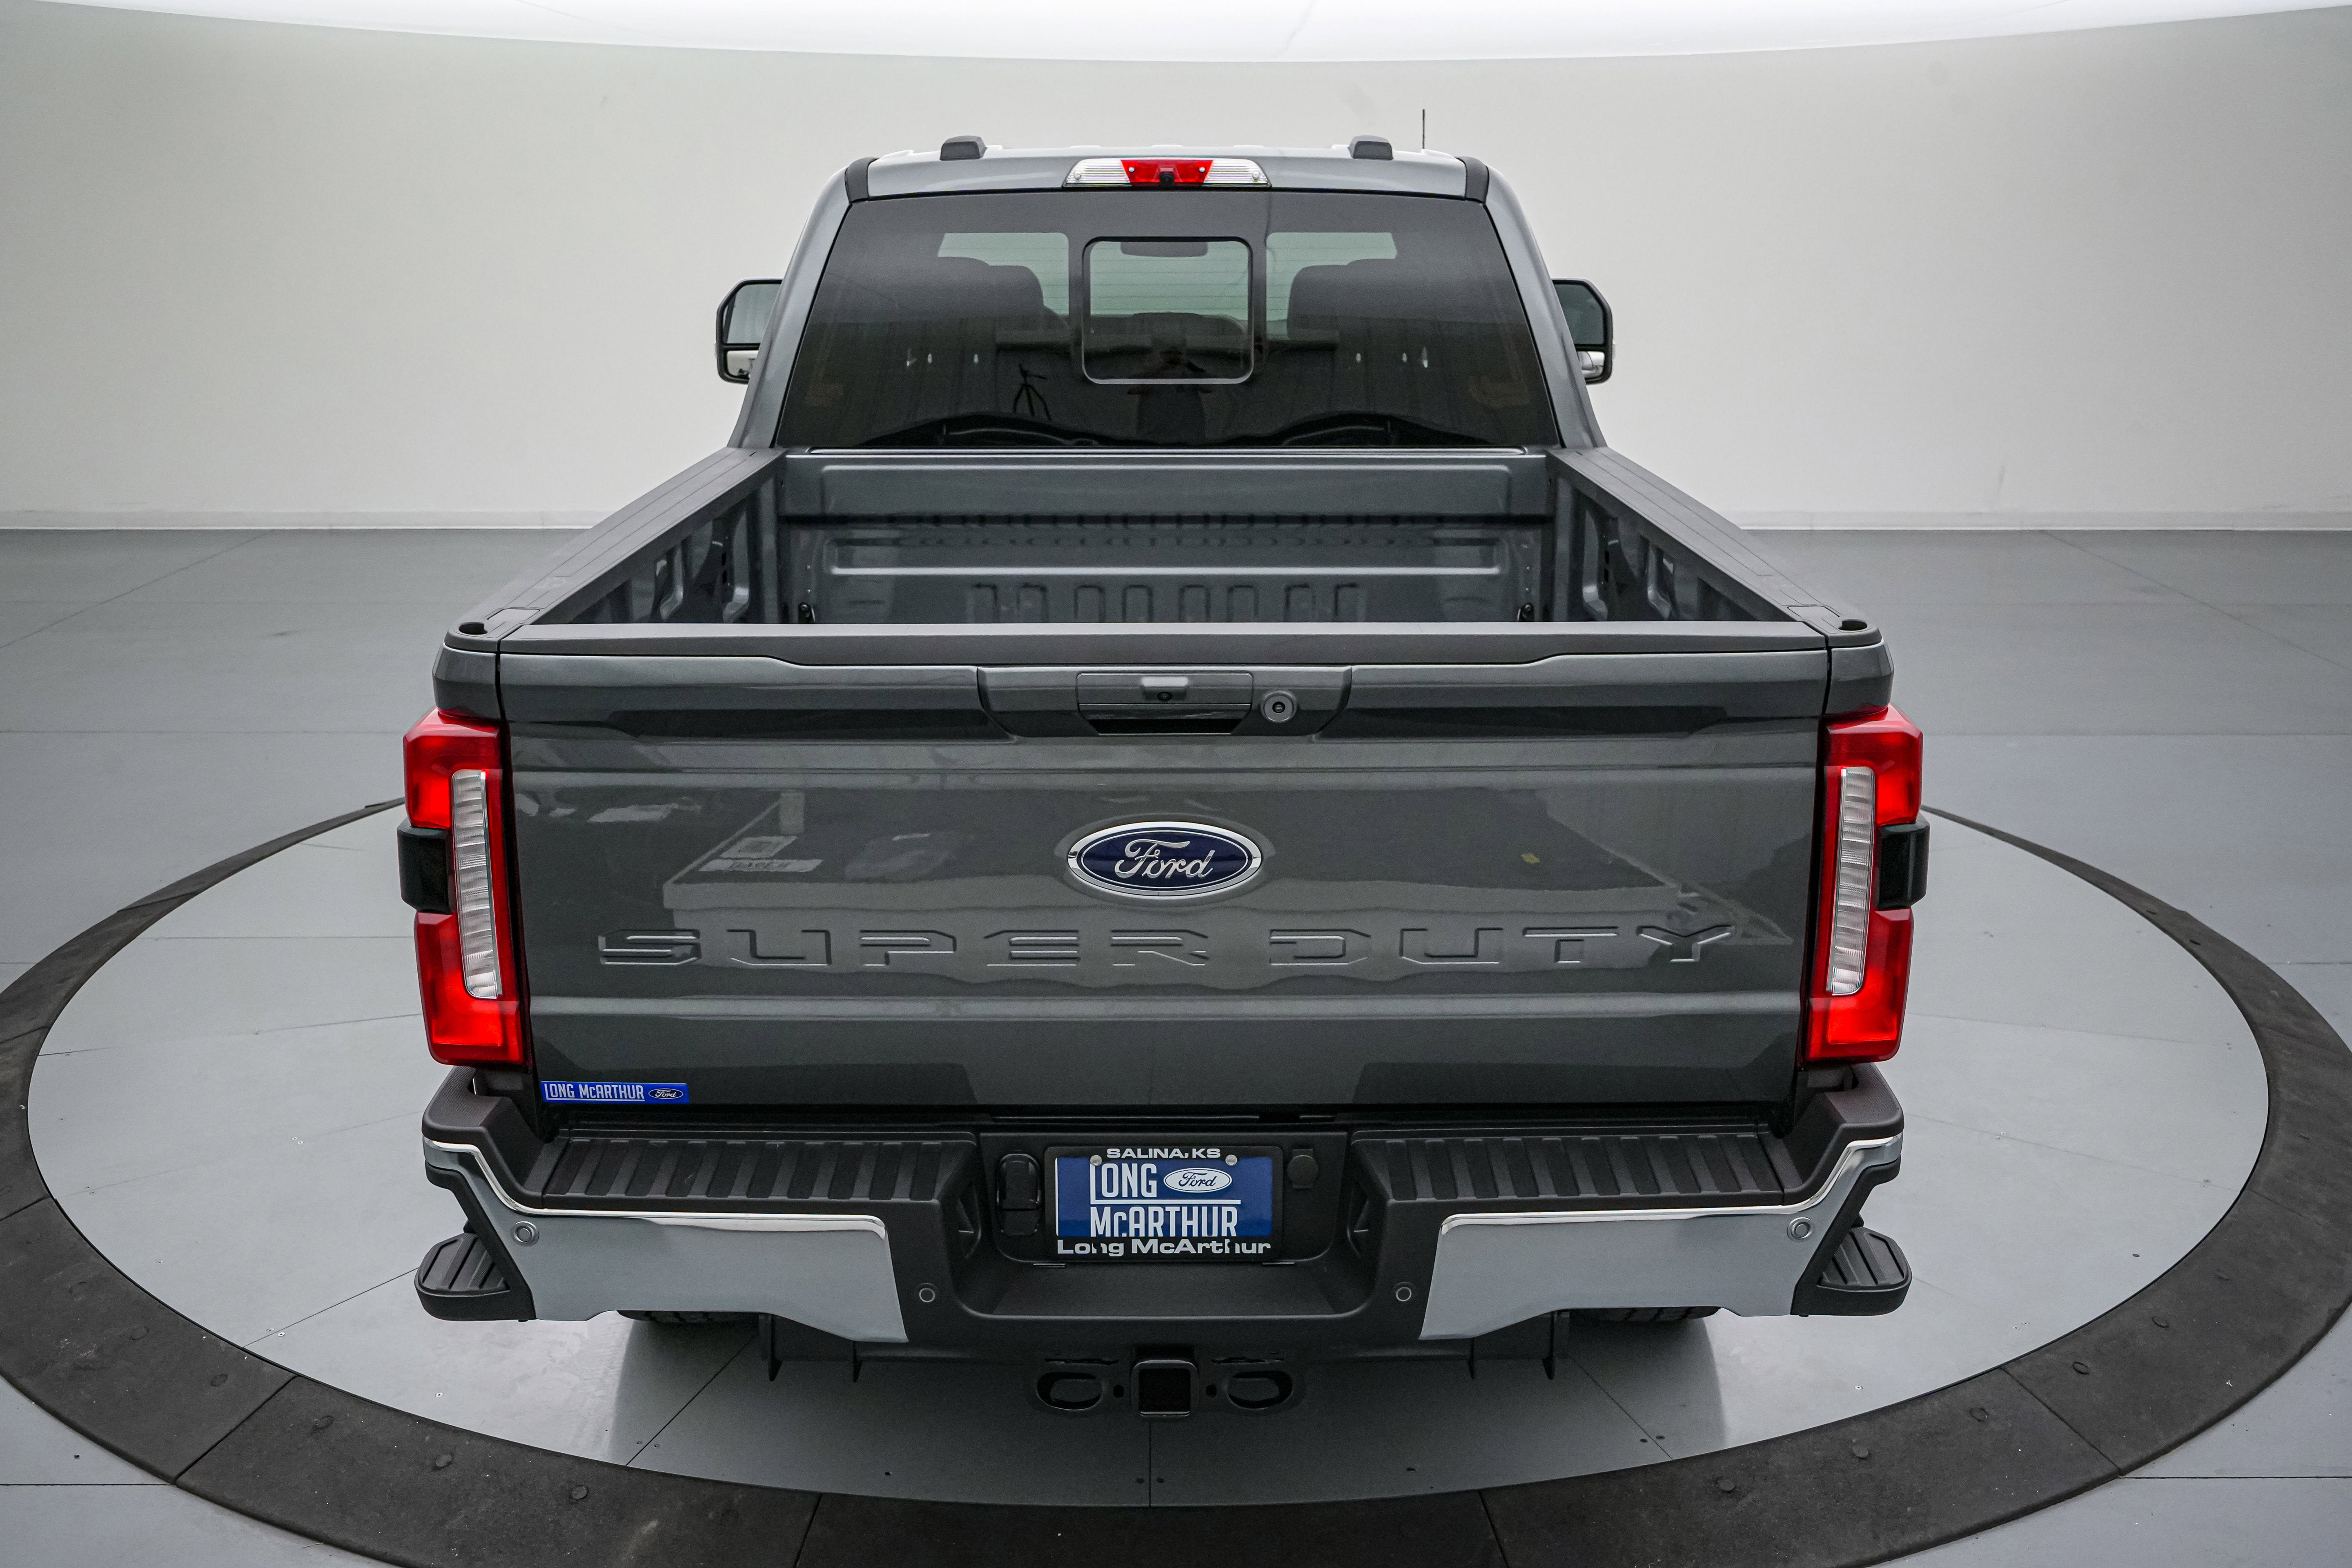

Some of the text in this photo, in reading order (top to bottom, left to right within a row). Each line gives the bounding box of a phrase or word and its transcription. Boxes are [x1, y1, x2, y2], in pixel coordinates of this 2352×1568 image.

[1114, 839, 1216, 878] Ford
[598, 925, 1734, 967] SUPER DUTY
[544, 1083, 645, 1100] LONG McARTHUR
[655, 1089, 677, 1098] Ford
[1107, 1148, 1221, 1158] SALINA, KS
[1090, 1163, 1157, 1204] LONG
[1178, 1171, 1217, 1187] Ford
[1090, 1206, 1237, 1237] McARTHUR
[1057, 1238, 1271, 1257] Long McArthur
